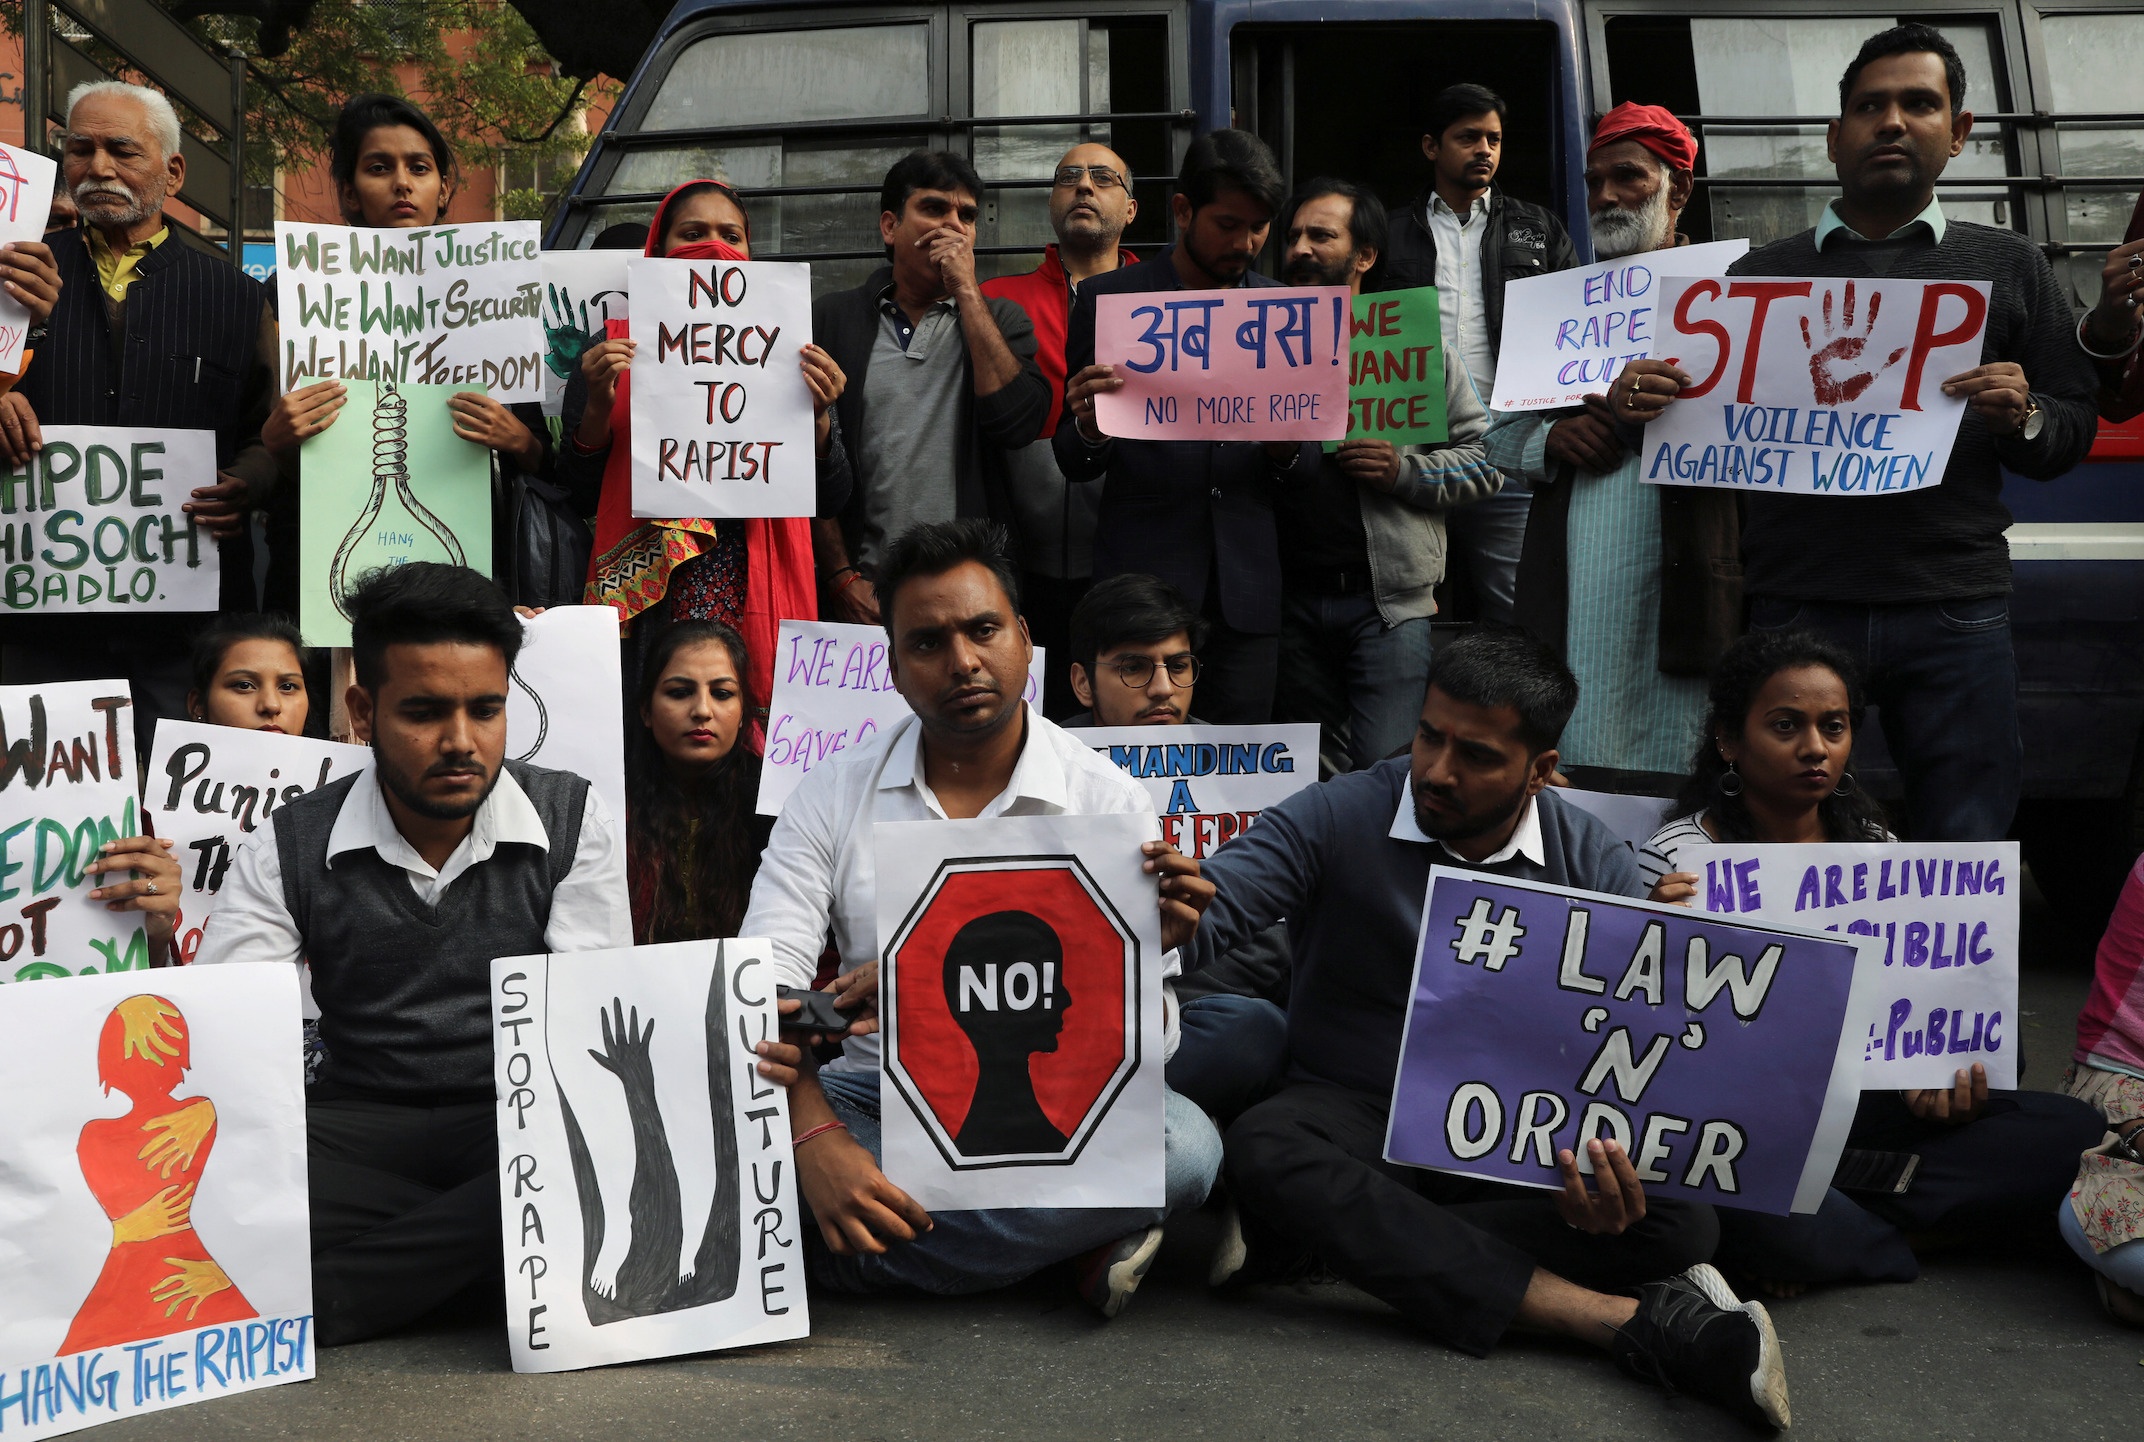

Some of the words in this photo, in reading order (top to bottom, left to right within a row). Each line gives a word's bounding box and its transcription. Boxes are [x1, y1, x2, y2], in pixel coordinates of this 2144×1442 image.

[286, 231, 341, 275] WE
[350, 230, 431, 276] WANT
[297, 282, 352, 332] WE
[360, 280, 440, 337] WANT
[688, 265, 747, 309] NO
[1585, 265, 1652, 306] END
[658, 321, 781, 368] MERCY
[1125, 299, 1224, 374] अब
[1350, 301, 1402, 339] WE
[1555, 308, 1652, 350] RAPE
[415, 333, 540, 392] FREEDOM
[694, 381, 748, 425] TO
[1145, 397, 1177, 425] NO
[1198, 396, 1256, 424] MORE
[1270, 394, 1321, 422] RAPE
[1520, 397, 1557, 407] JUSTICE
[1724, 405, 1901, 450] VOILENCE
[658, 438, 784, 484] RAPIST
[1649, 442, 1795, 488] AGAINST
[1811, 451, 1934, 492] WOMEN
[41, 510, 202, 569] SOCH
[787, 635, 837, 687] WE
[0, 694, 132, 793] WANT
[1095, 742, 1296, 779] MANDING
[1166, 779, 1200, 814] A
[1706, 858, 1762, 913] WE
[1795, 863, 1868, 912] ARE
[1877, 859, 2006, 900] LIVING
[959, 961, 1055, 1012] NO!
[1557, 906, 1786, 1021] LAW
[501, 972, 535, 1129] STOP
[732, 958, 793, 1316] CULTURE
[1444, 1080, 1748, 1193] ORDER
[507, 1154, 550, 1350] RAPE
[0, 1353, 119, 1433] HANG
[123, 1340, 188, 1406] THE
[195, 1315, 313, 1392] RAPIST
